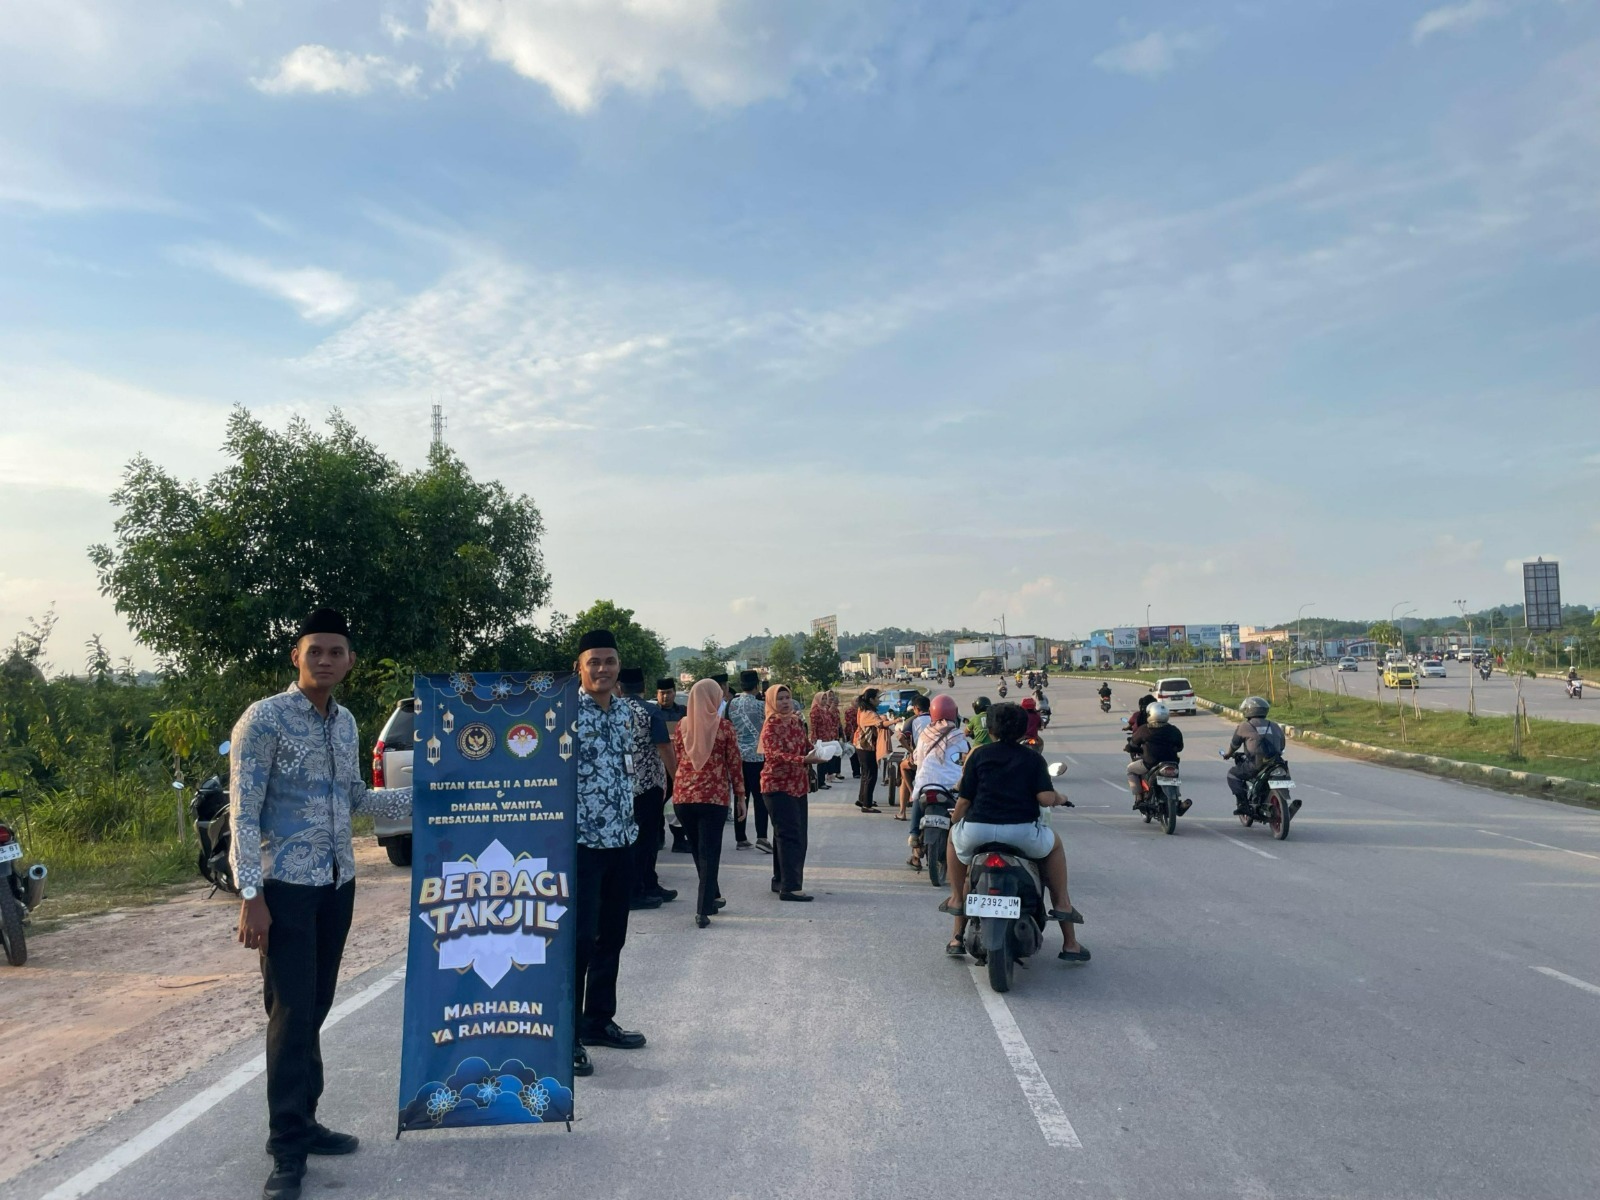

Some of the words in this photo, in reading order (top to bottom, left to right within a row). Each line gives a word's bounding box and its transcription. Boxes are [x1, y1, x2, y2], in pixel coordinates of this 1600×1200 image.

[430, 782, 464, 790] RUTAN
[468, 780, 500, 789] KELAS
[503, 780, 510, 788] II
[514, 779, 521, 788] A
[524, 778, 558, 787] BATAM
[496, 790, 505, 798] &
[451, 801, 498, 812] DHARMA
[501, 800, 542, 810] WANITA
[428, 815, 489, 825] PERSATUAN
[493, 813, 526, 822] RUTAN
[530, 812, 564, 821] BATAM
[418, 870, 570, 906] BERBAGI
[968, 896, 978, 905] BP
[981, 897, 1002, 907] 2392
[1008, 898, 1019, 907] UM
[430, 899, 559, 935] TAKJIL
[444, 1001, 543, 1020] MARHABAN
[432, 1028, 453, 1044] YA
[459, 1021, 554, 1038] RAMADHAN
